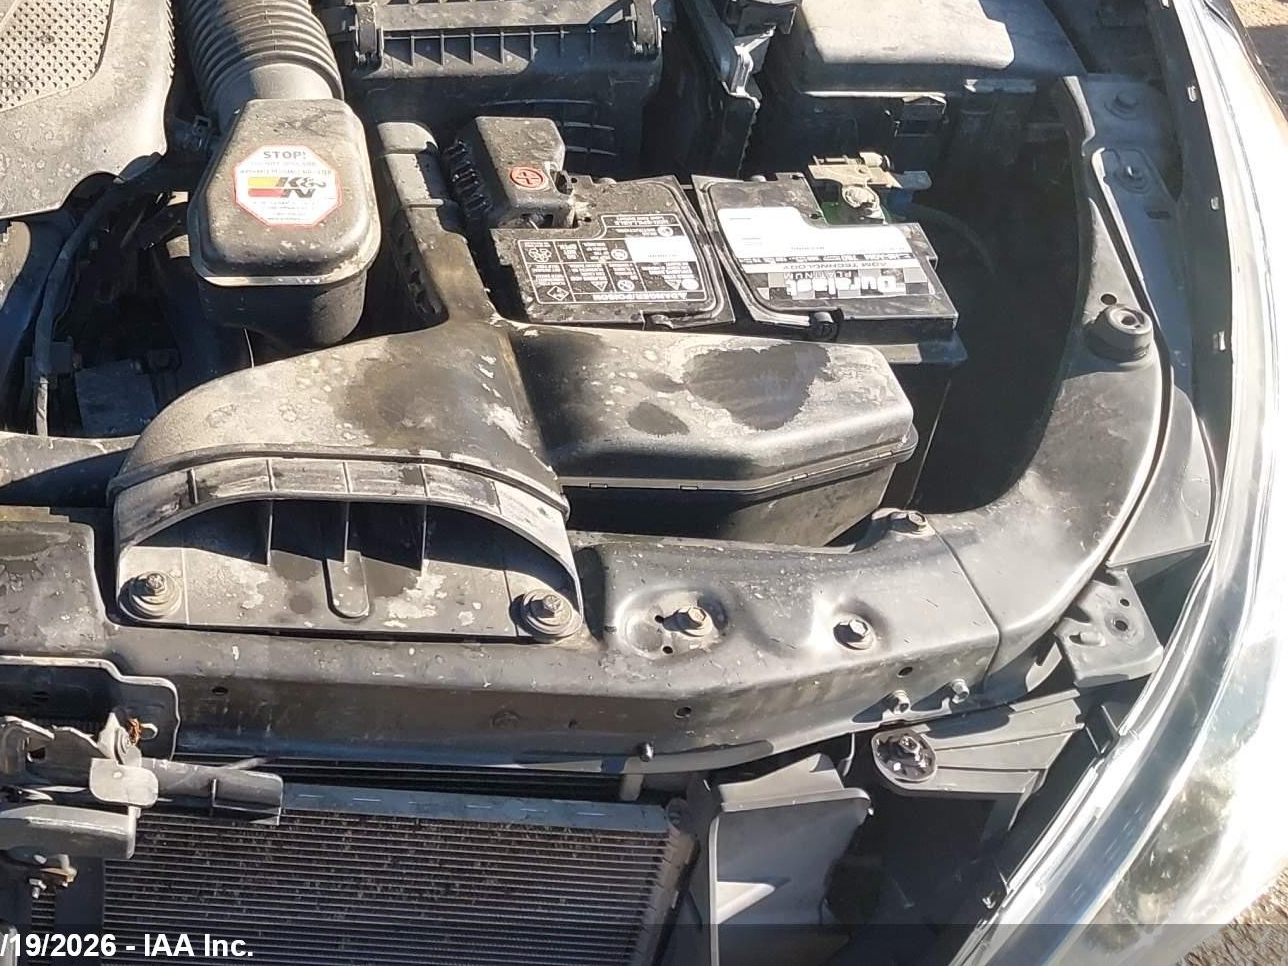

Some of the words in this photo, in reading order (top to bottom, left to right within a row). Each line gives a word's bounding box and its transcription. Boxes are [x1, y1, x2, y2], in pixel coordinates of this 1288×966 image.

[263, 150, 307, 160] STOP!
[783, 270, 852, 279] PLATINUM
[785, 275, 897, 297] Duralast
